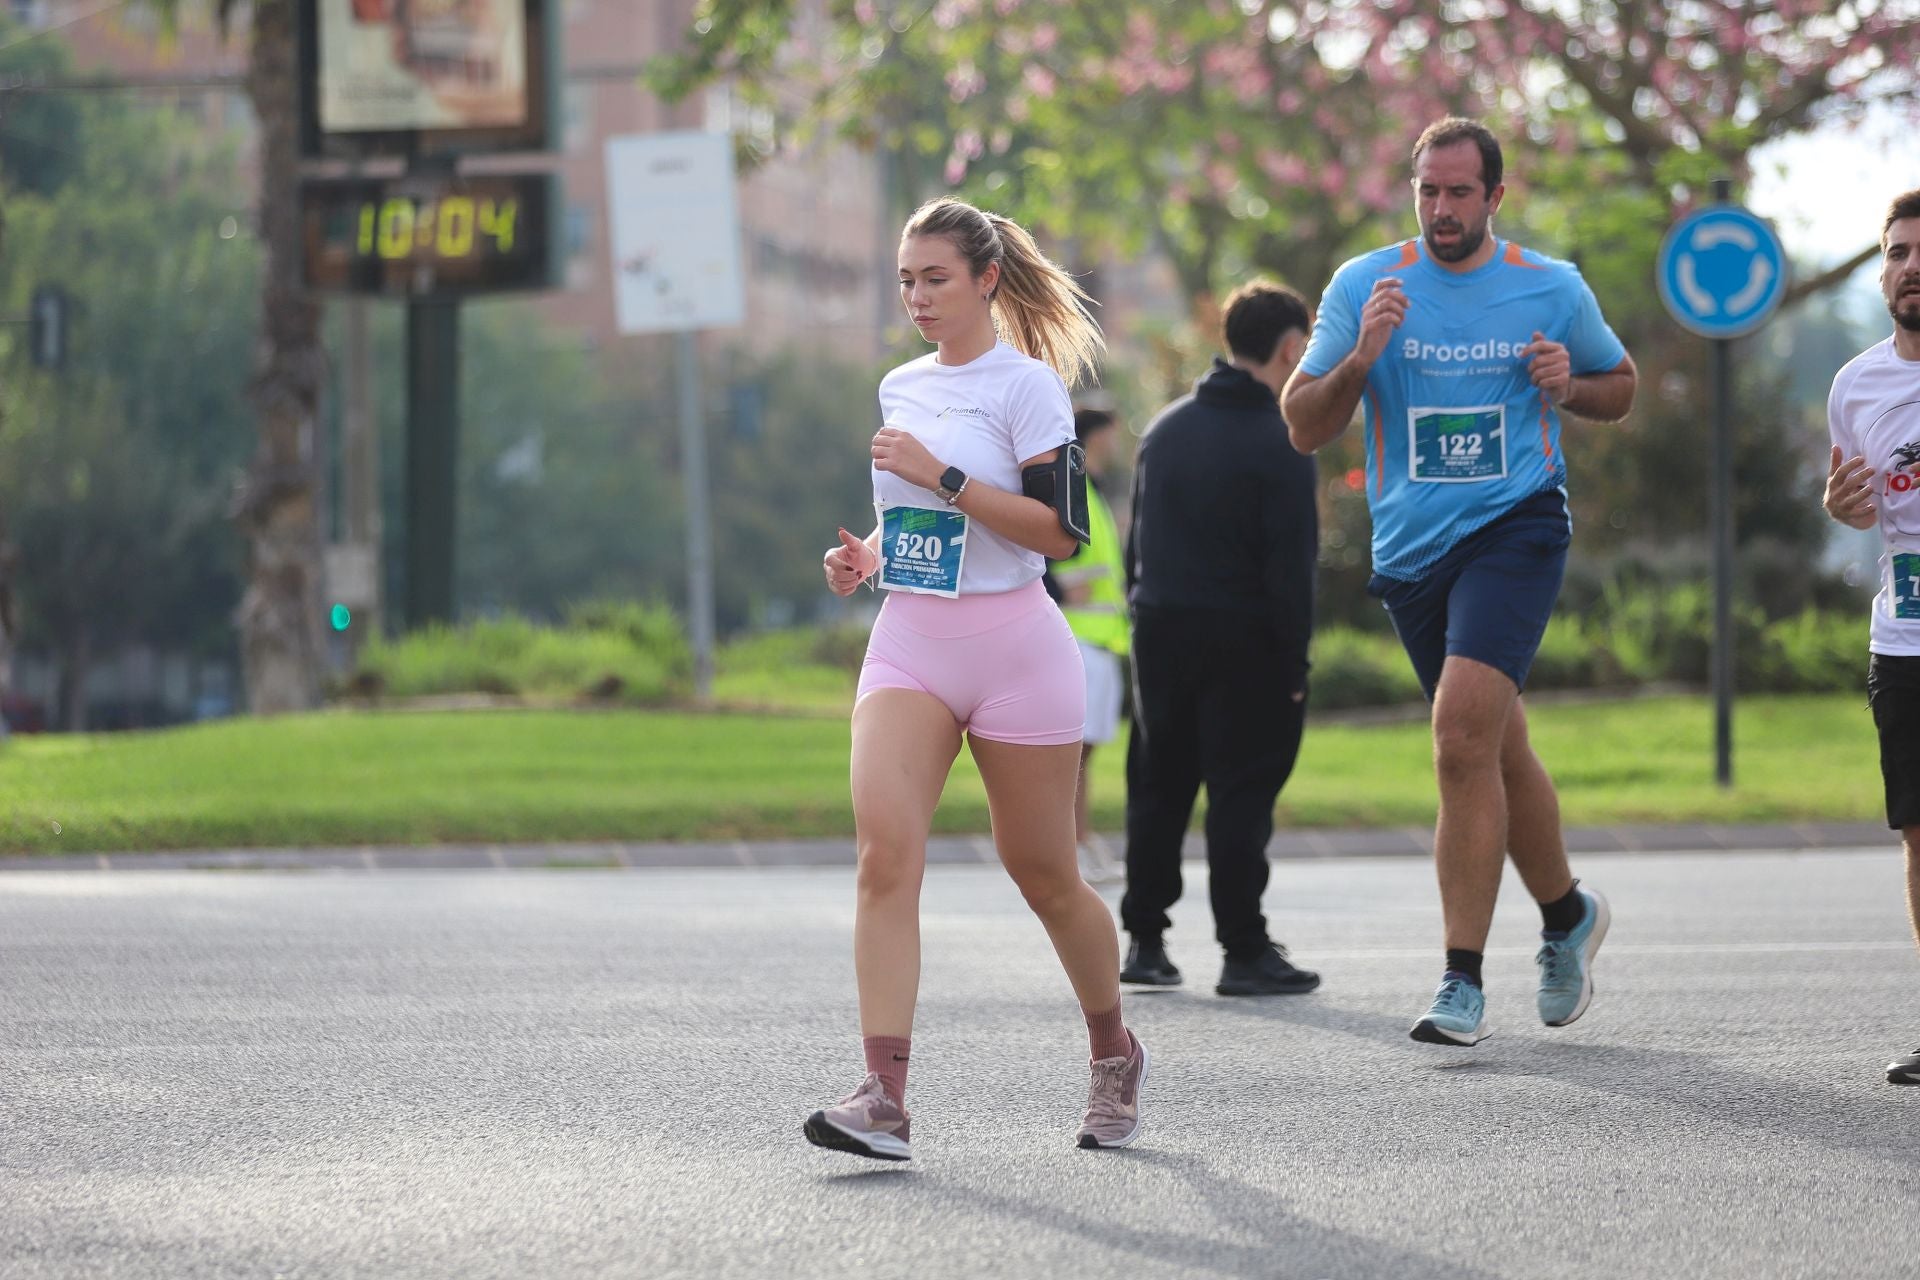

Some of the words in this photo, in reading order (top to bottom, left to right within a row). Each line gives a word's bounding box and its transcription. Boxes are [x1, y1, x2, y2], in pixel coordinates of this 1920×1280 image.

[357, 198, 516, 259] 10:04
[1437, 433, 1482, 456] 122
[895, 532, 942, 561] 520
